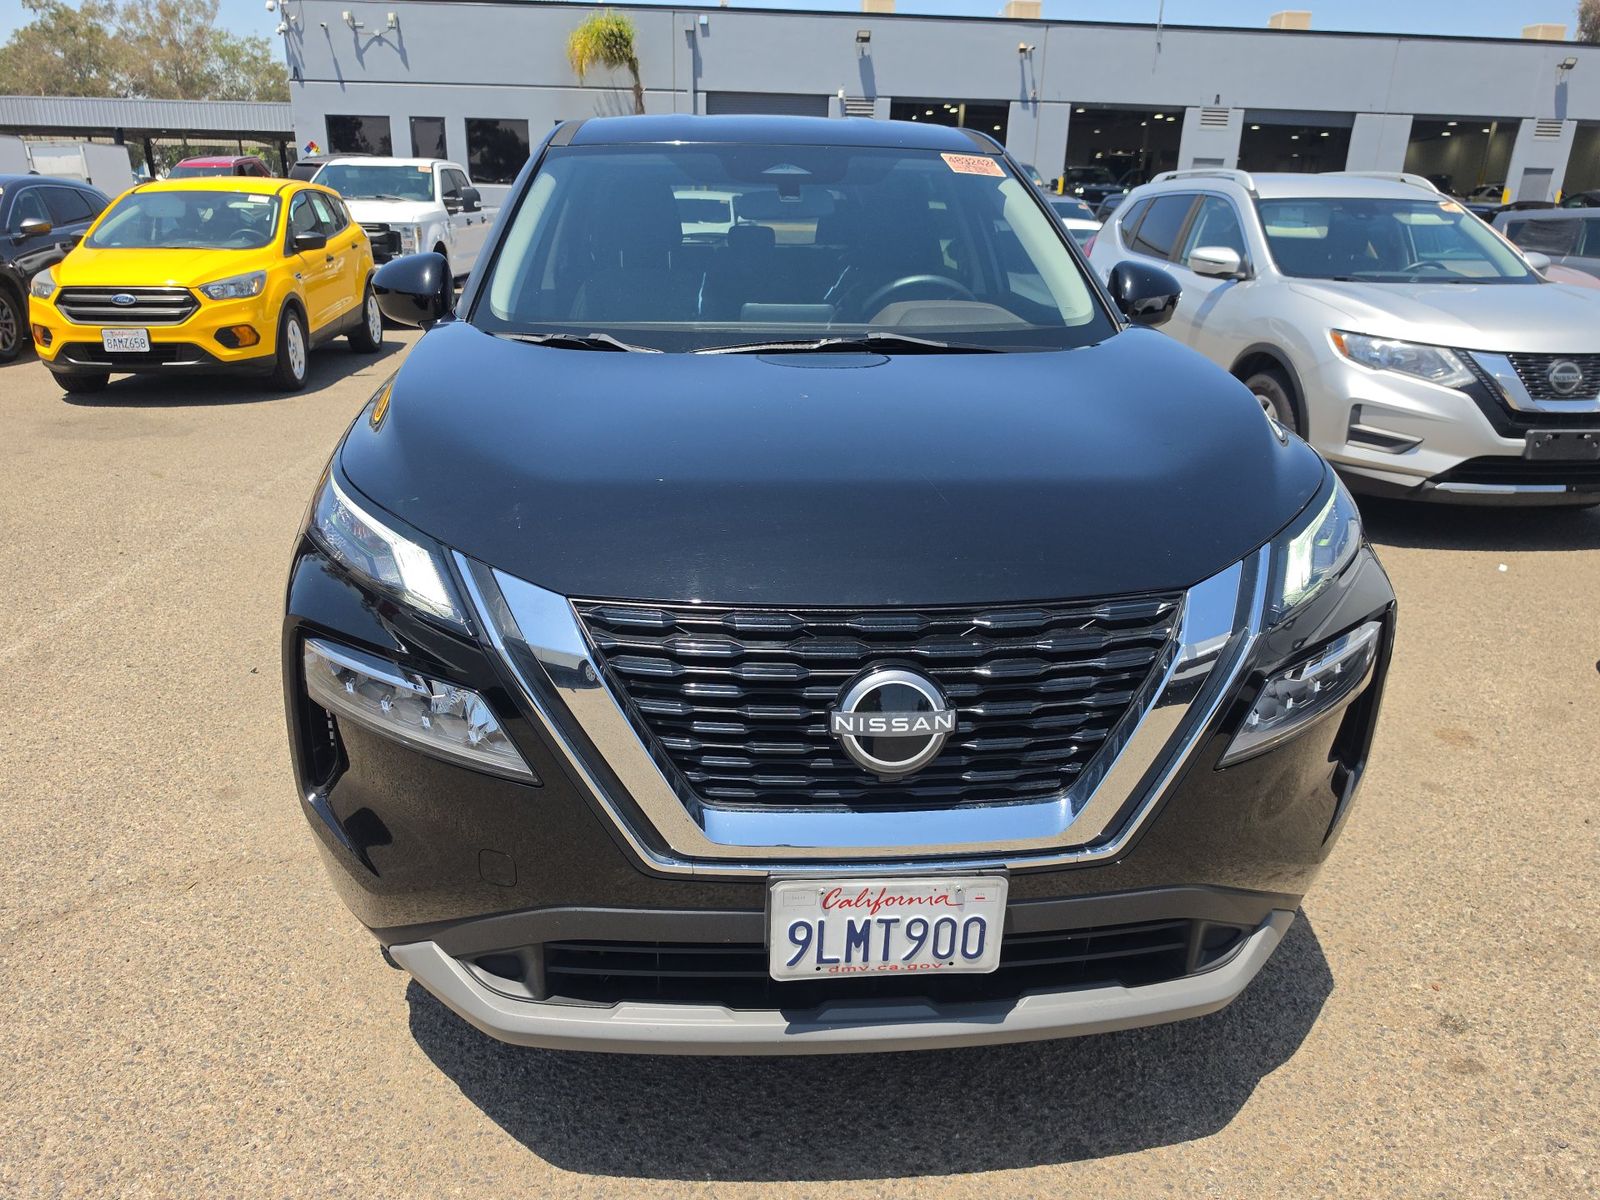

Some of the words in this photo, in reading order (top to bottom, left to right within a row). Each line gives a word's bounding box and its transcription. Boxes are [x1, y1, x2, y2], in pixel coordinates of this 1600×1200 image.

[107, 337, 146, 349] 8AMZ658
[835, 714, 952, 732] NISSAN
[822, 887, 962, 915] California
[786, 916, 987, 967] 9LMT900
[828, 962, 943, 973] dmv.ca.gov
